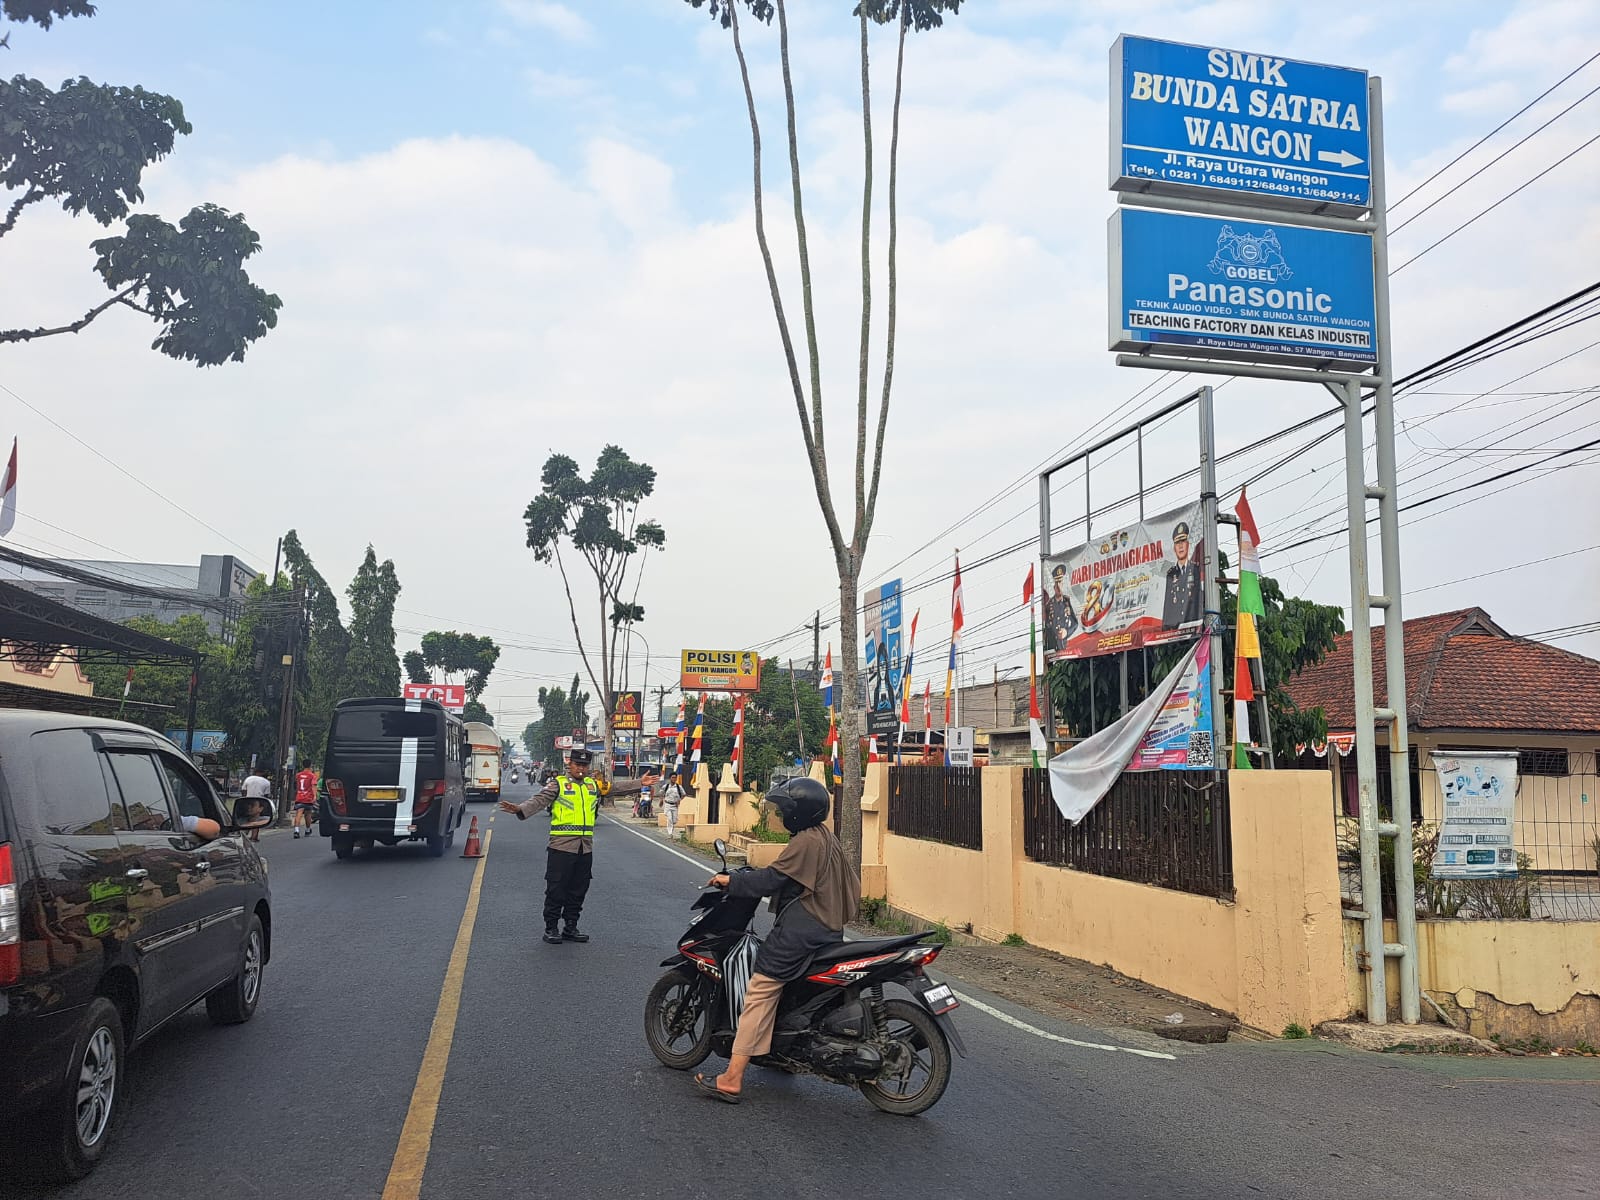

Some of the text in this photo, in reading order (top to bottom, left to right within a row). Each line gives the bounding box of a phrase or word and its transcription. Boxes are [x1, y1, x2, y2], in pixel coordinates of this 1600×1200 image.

[1208, 48, 1287, 87] SMK
[1130, 71, 1361, 132] BUNDA SATRIA
[1183, 116, 1312, 161] WANGON
[1129, 163, 1158, 176] Telp.
[1163, 153, 1328, 186] Jl. Raya Utara Wangon
[1226, 265, 1276, 283] GOBEL
[1168, 273, 1333, 314] Panasonic
[1129, 312, 1370, 346] TEACHING FACTORY DAN KELAS INDUSTRI
[1136, 299, 1170, 310] TEKNIK
[1172, 302, 1202, 312] AUDIO
[1204, 305, 1232, 315] VIDEO
[1240, 308, 1260, 318] SMK
[1263, 310, 1294, 321] BUNDA
[1297, 314, 1329, 324] SATRIA
[1331, 317, 1370, 328] WANGON
[1208, 338, 1226, 348] Raya
[1228, 340, 1248, 349] Utara
[1250, 342, 1279, 352] Wangon
[1338, 350, 1375, 360] Banyumas
[1071, 564, 1092, 586] HARI
[1093, 540, 1164, 579] BHAYANGKARA
[687, 652, 736, 664] POLISI
[408, 687, 460, 704] TCL
[300, 778, 305, 790] 1
